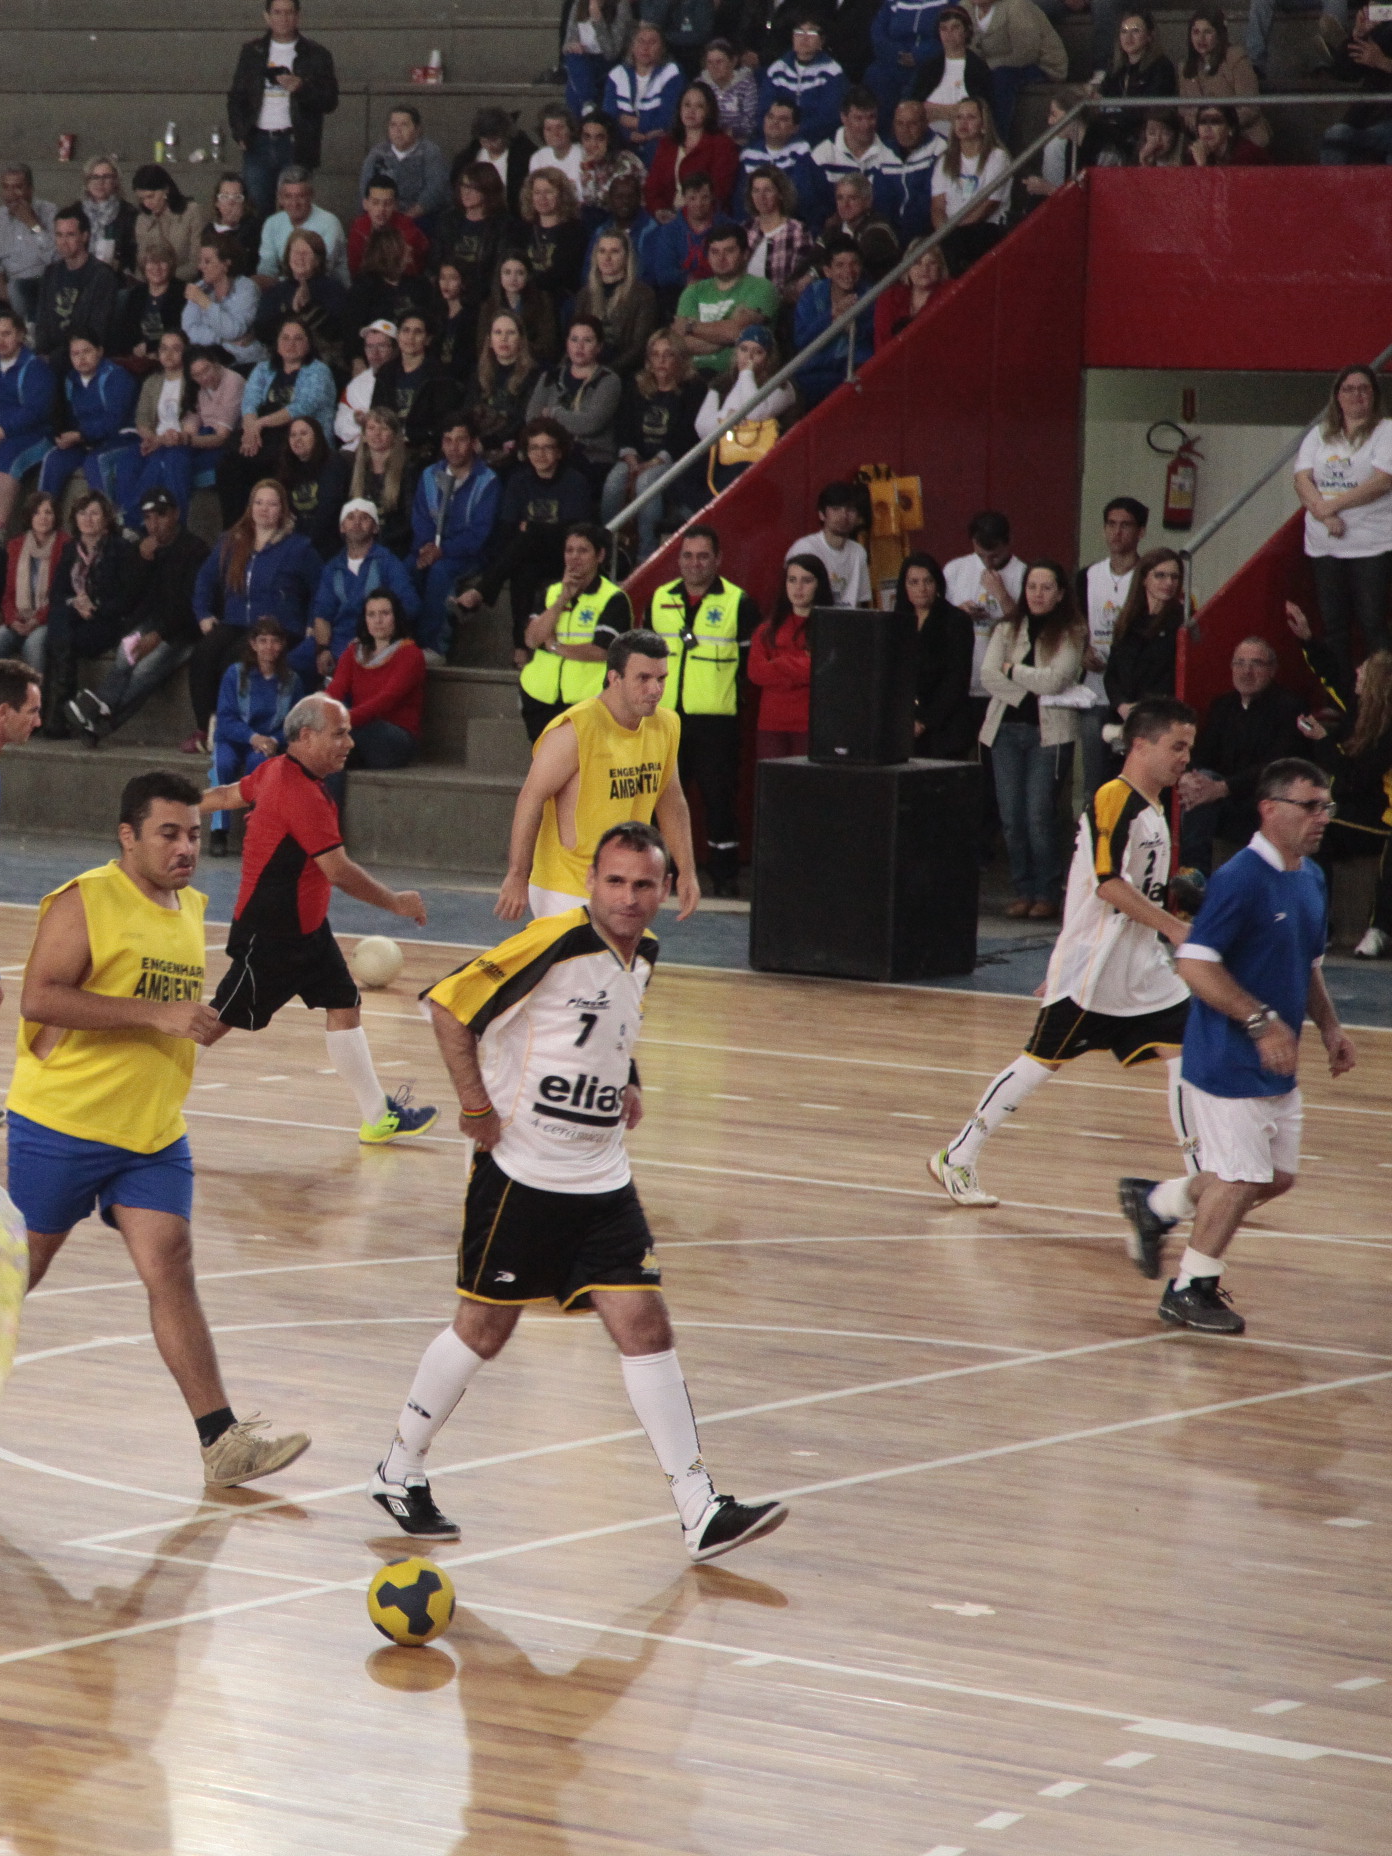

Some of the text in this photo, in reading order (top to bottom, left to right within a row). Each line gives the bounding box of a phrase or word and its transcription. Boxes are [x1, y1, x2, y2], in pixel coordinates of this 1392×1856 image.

[610, 762, 661, 778] ENGENARIA
[1144, 850, 1157, 876] 2
[141, 957, 205, 977] ENGENHARI
[132, 971, 203, 1002] AMBIENT
[574, 1013, 598, 1047] 7
